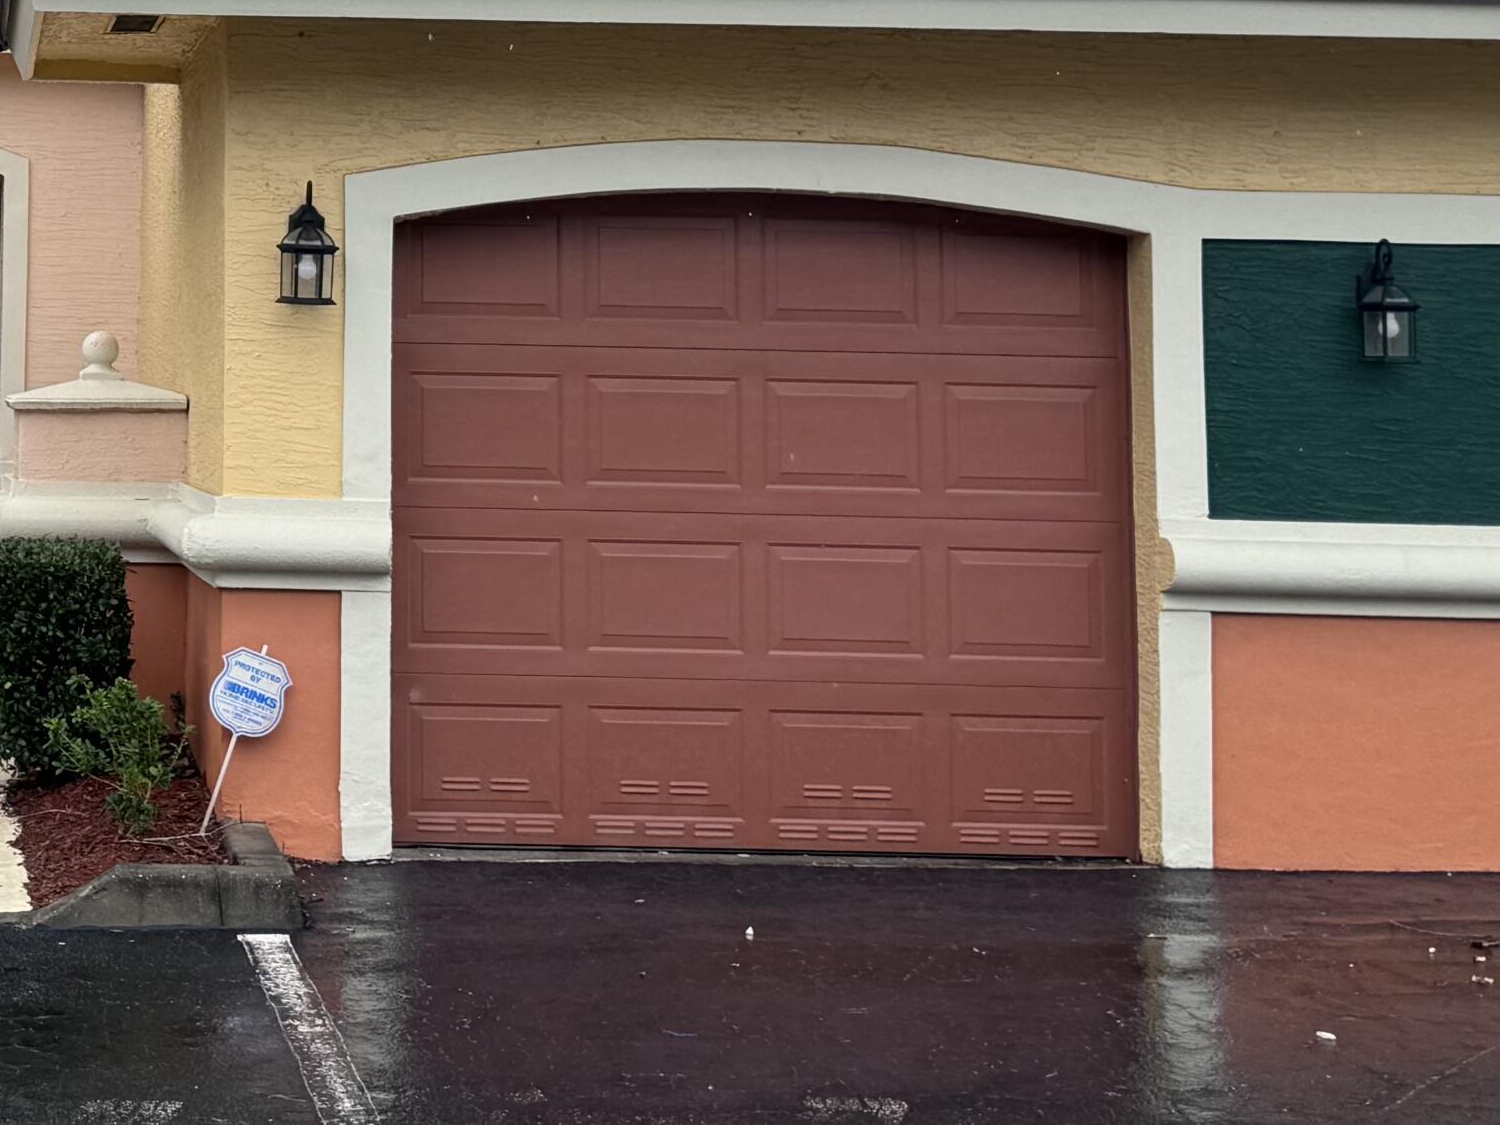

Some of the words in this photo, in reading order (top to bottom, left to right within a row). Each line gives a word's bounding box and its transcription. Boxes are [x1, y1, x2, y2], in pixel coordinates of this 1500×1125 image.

[234, 660, 281, 683] PROTECTED
[250, 675, 261, 683] BY
[232, 683, 278, 709] BRINKS
